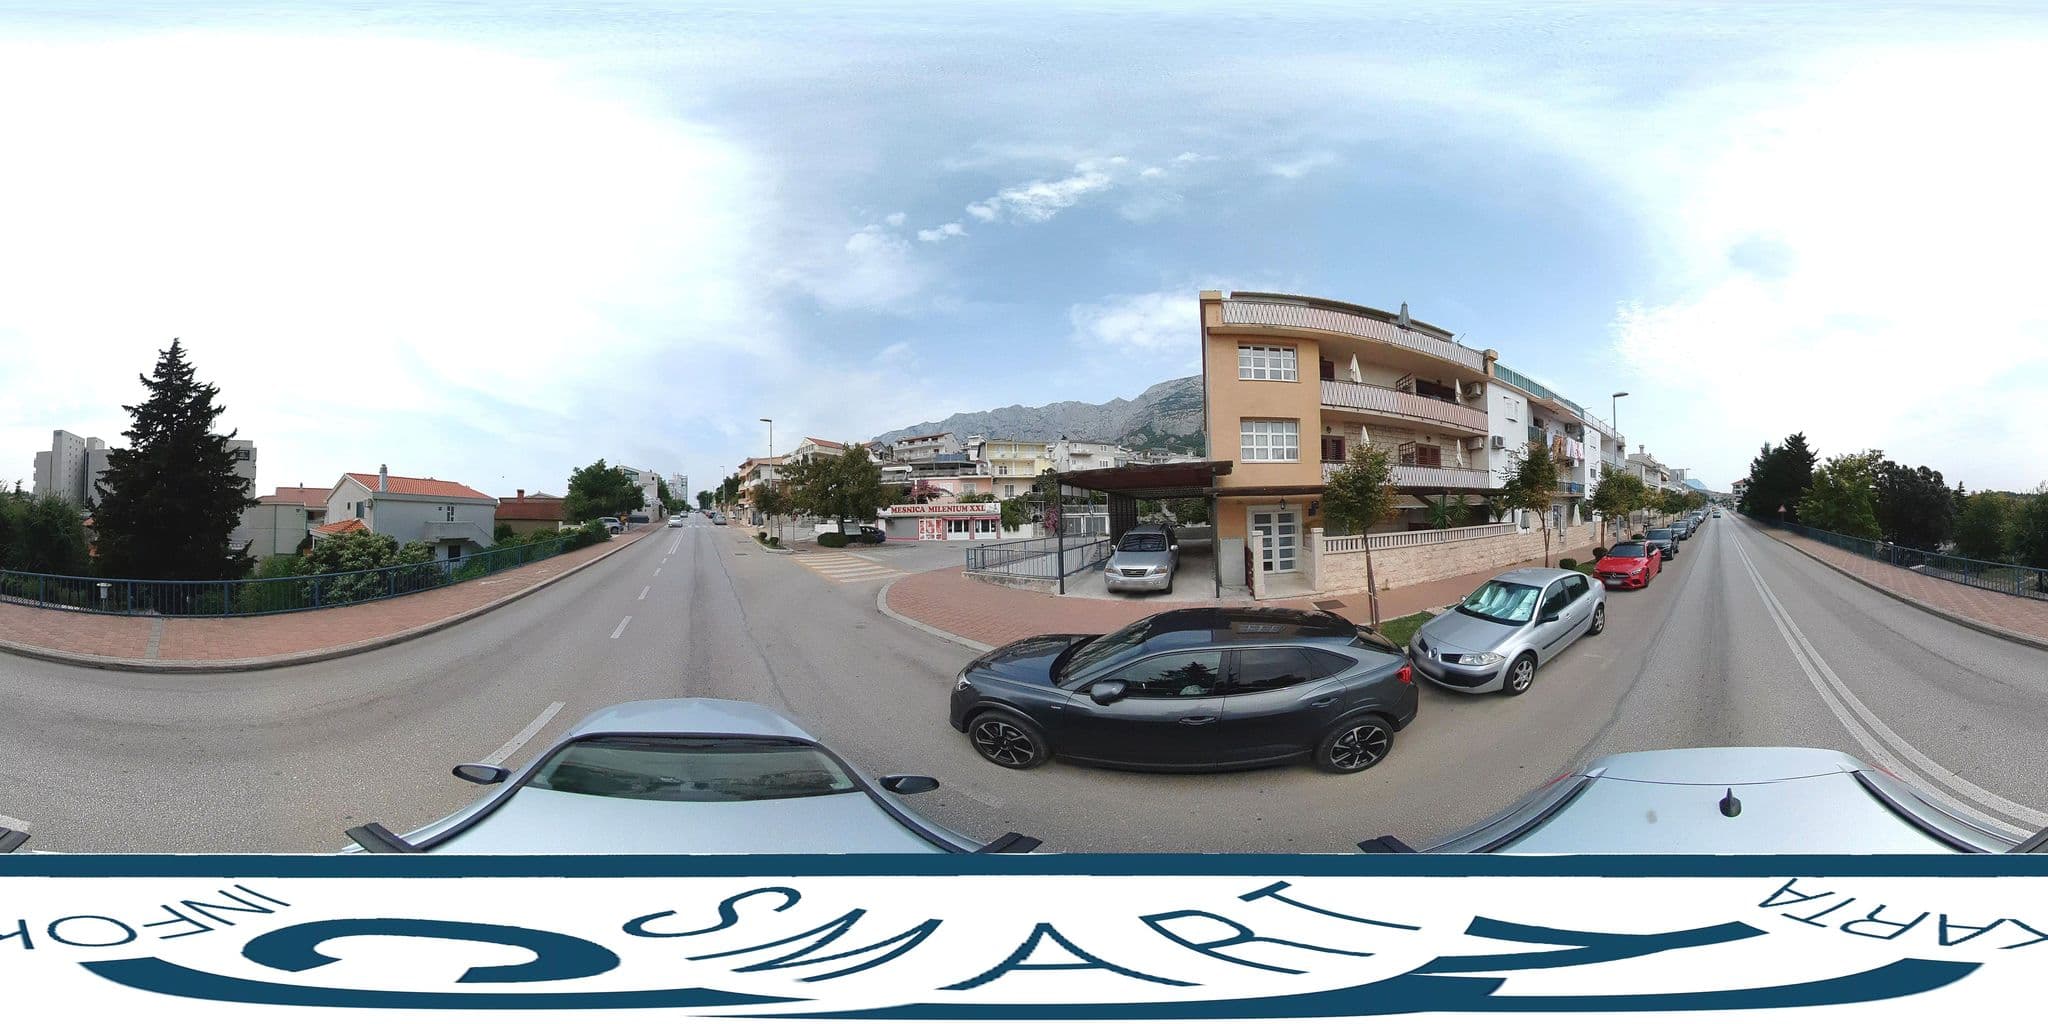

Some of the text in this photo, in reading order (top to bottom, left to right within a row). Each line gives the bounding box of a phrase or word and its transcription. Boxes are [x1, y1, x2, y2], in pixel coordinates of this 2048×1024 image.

[891, 504, 986, 514] MESNICA MILENIUM XXL
